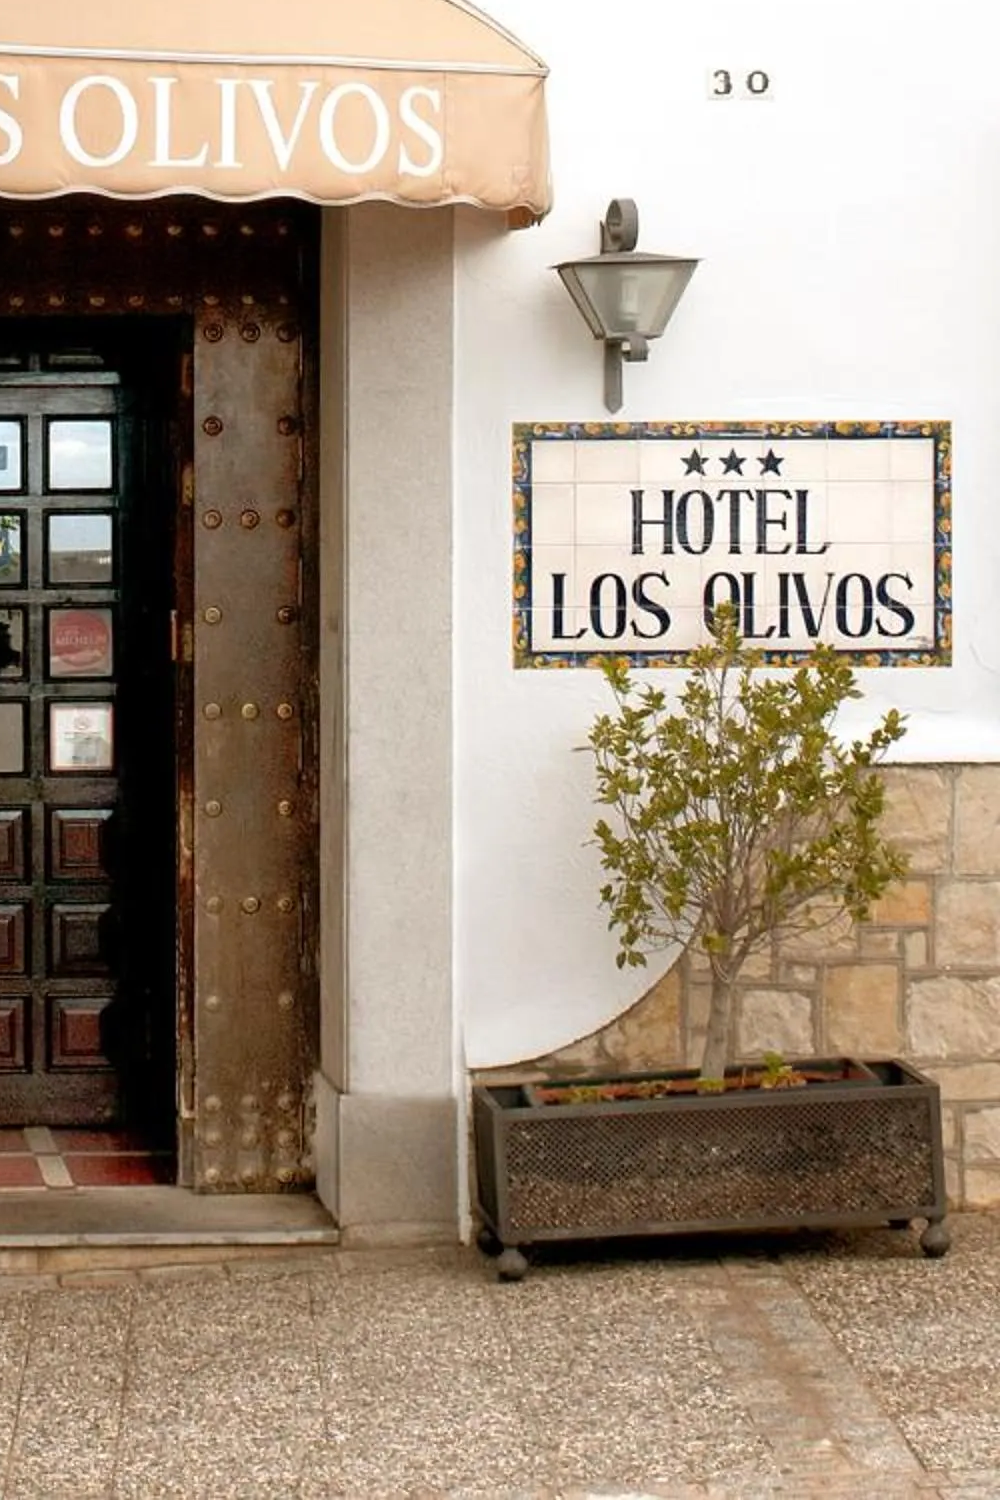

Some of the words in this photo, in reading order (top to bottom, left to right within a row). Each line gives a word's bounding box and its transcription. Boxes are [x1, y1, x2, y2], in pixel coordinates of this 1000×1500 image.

[713, 69, 769, 95] 30
[59, 74, 443, 177] OLIVOS
[630, 489, 833, 555] HOTEL
[551, 570, 671, 639] LOS
[703, 571, 915, 639] OLIVOS
